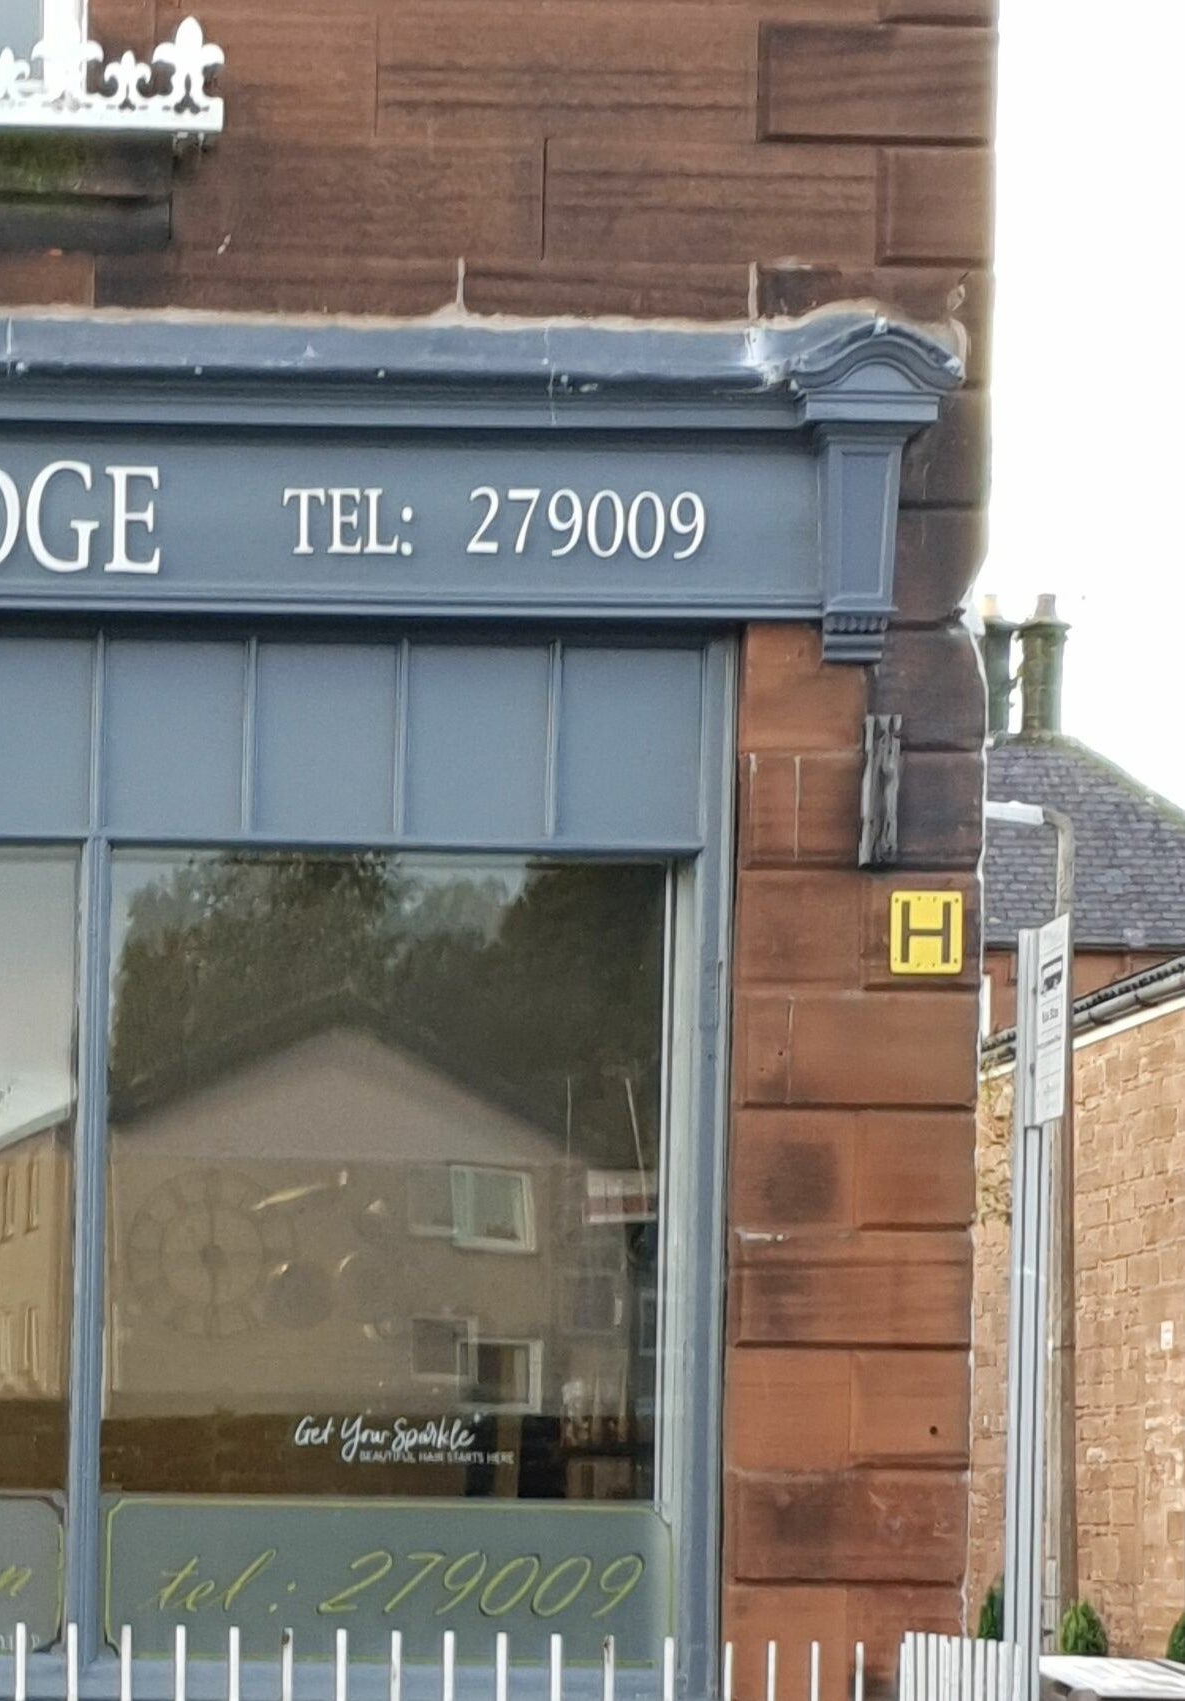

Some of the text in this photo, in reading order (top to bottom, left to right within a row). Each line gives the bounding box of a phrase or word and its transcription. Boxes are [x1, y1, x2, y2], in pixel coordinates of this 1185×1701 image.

[282, 486, 415, 557] TEL:
[465, 486, 707, 560] 279009
[900, 900, 952, 964] H
[294, 1415, 475, 1462] Get Your Sparkle
[486, 1453, 515, 1465] HERE
[317, 1549, 646, 1618] 279009
